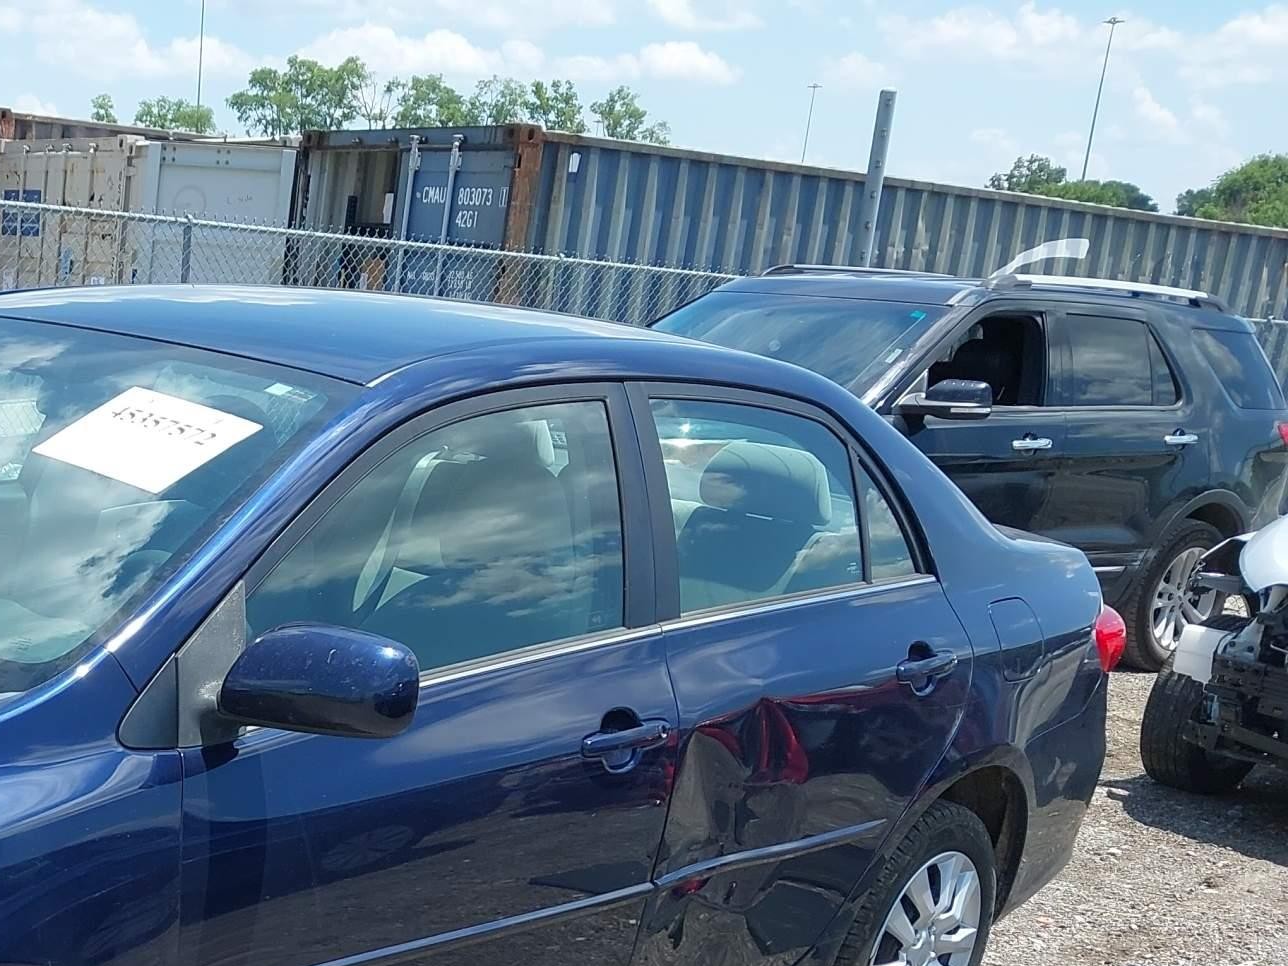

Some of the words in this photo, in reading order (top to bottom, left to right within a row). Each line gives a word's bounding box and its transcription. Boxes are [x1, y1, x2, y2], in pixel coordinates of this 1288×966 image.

[423, 186, 447, 203] CMAU
[458, 187, 493, 206] 803073
[456, 210, 478, 228] 42G1
[112, 406, 217, 445] 45357572
